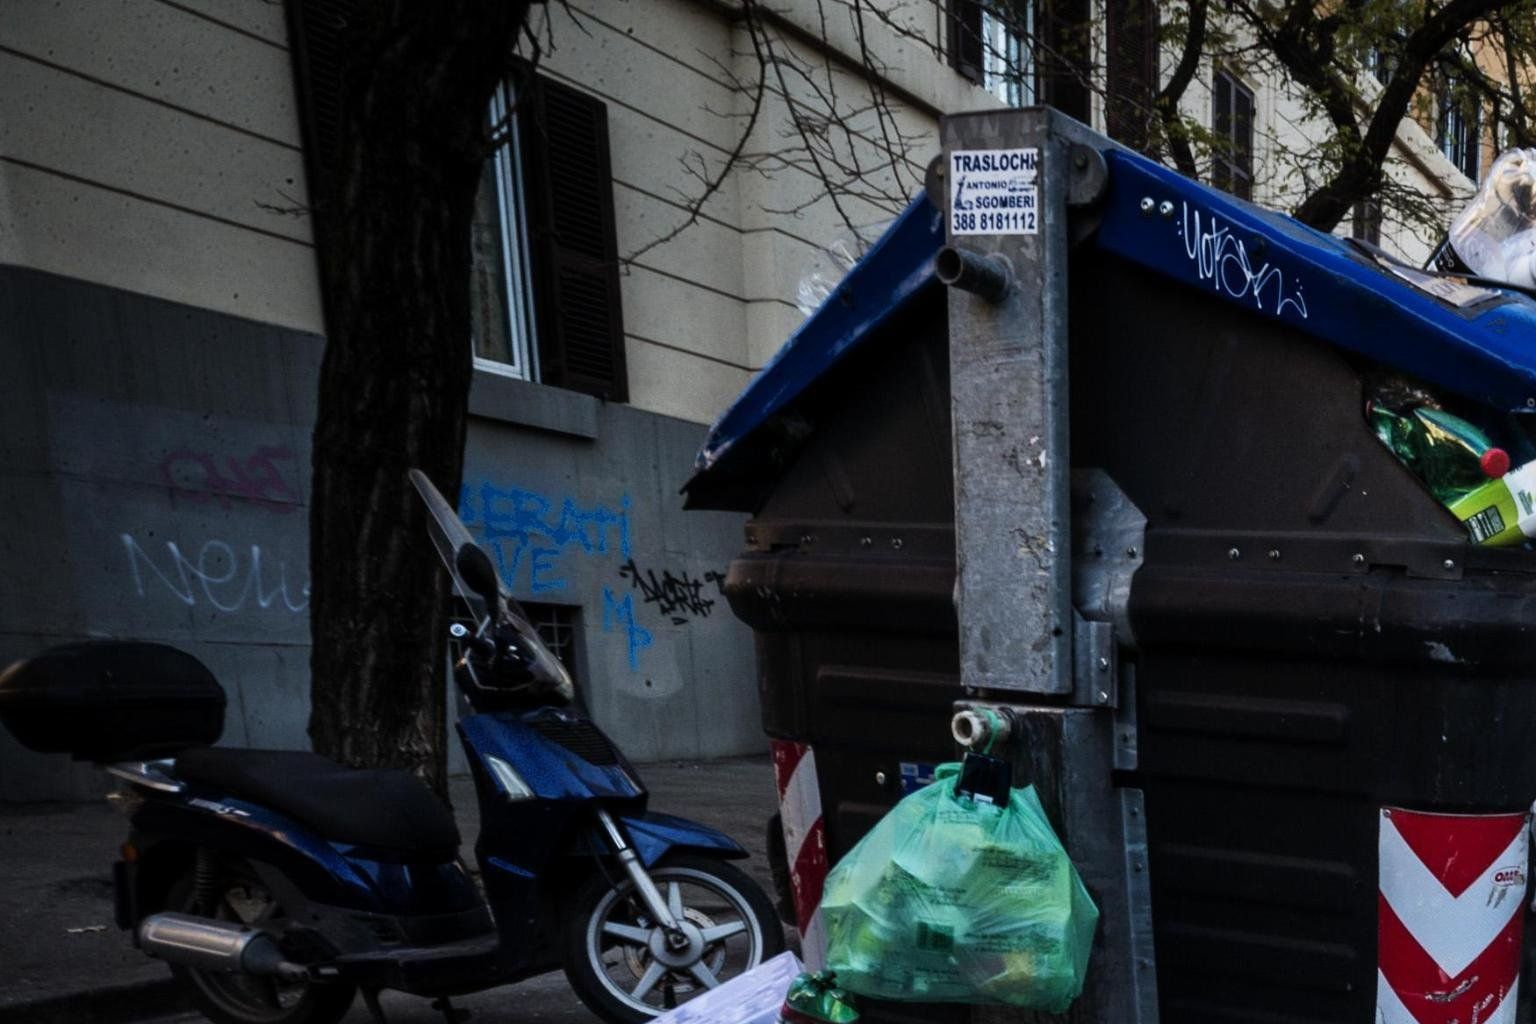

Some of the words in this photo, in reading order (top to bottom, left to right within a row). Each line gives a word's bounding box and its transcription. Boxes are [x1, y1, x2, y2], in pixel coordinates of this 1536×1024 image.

[966, 181, 1007, 189] ANTONIO
[975, 196, 1034, 209] SGOMBERI
[953, 213, 976, 230] 388
[980, 212, 1035, 230] 8181112
